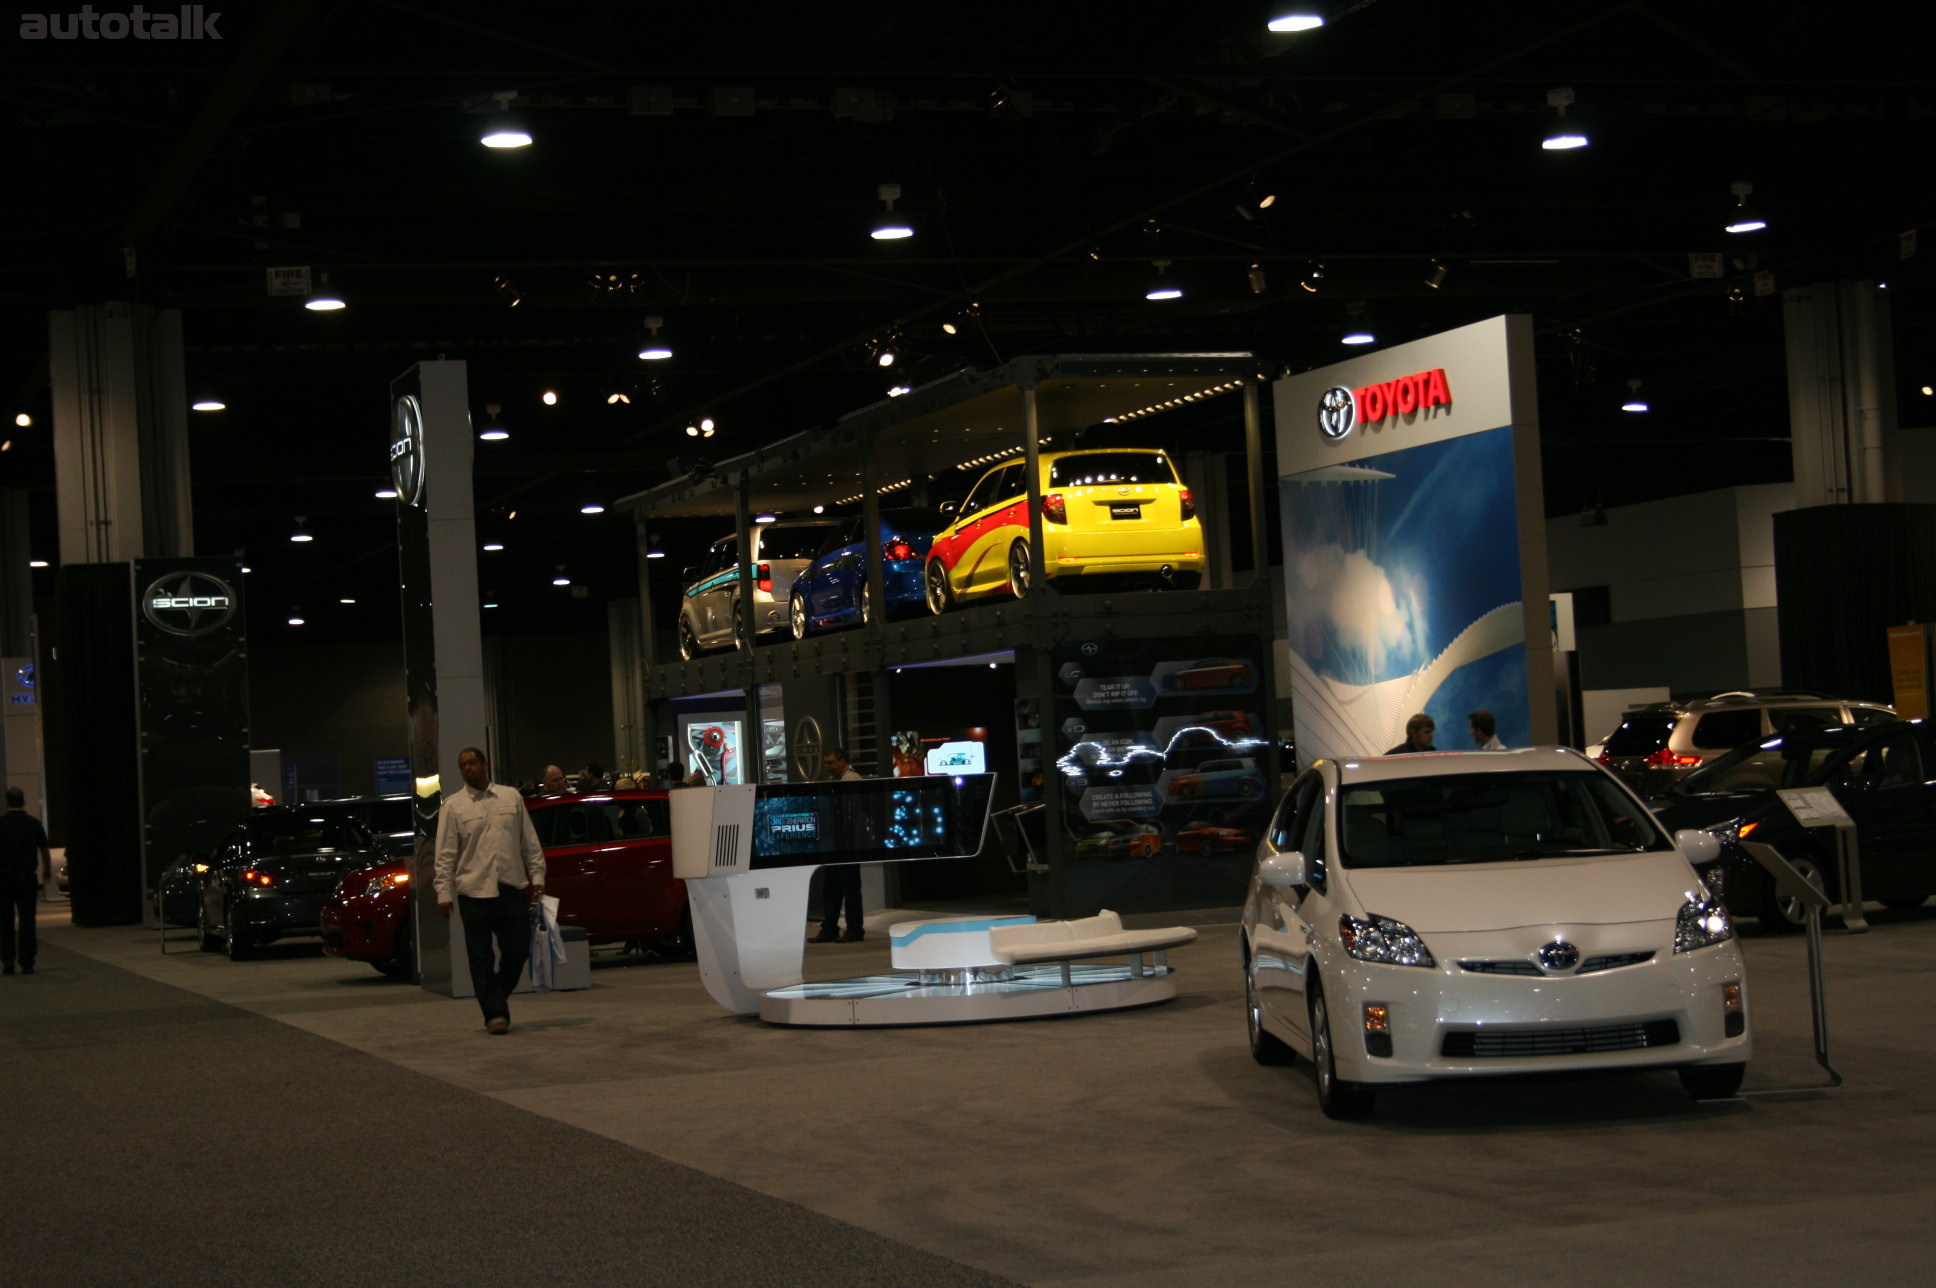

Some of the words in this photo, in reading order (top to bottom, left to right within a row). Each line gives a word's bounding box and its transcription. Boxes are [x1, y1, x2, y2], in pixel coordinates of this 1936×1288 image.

[1694, 254, 1717, 263] FIRE
[274, 269, 304, 279] FIRE
[1352, 368, 1452, 424] TOYOTA
[1093, 690, 1110, 698] DON'T
[1120, 689, 1127, 697] IT
[771, 823, 817, 833] PRIUS
[771, 831, 817, 840] EXPERIENCE
